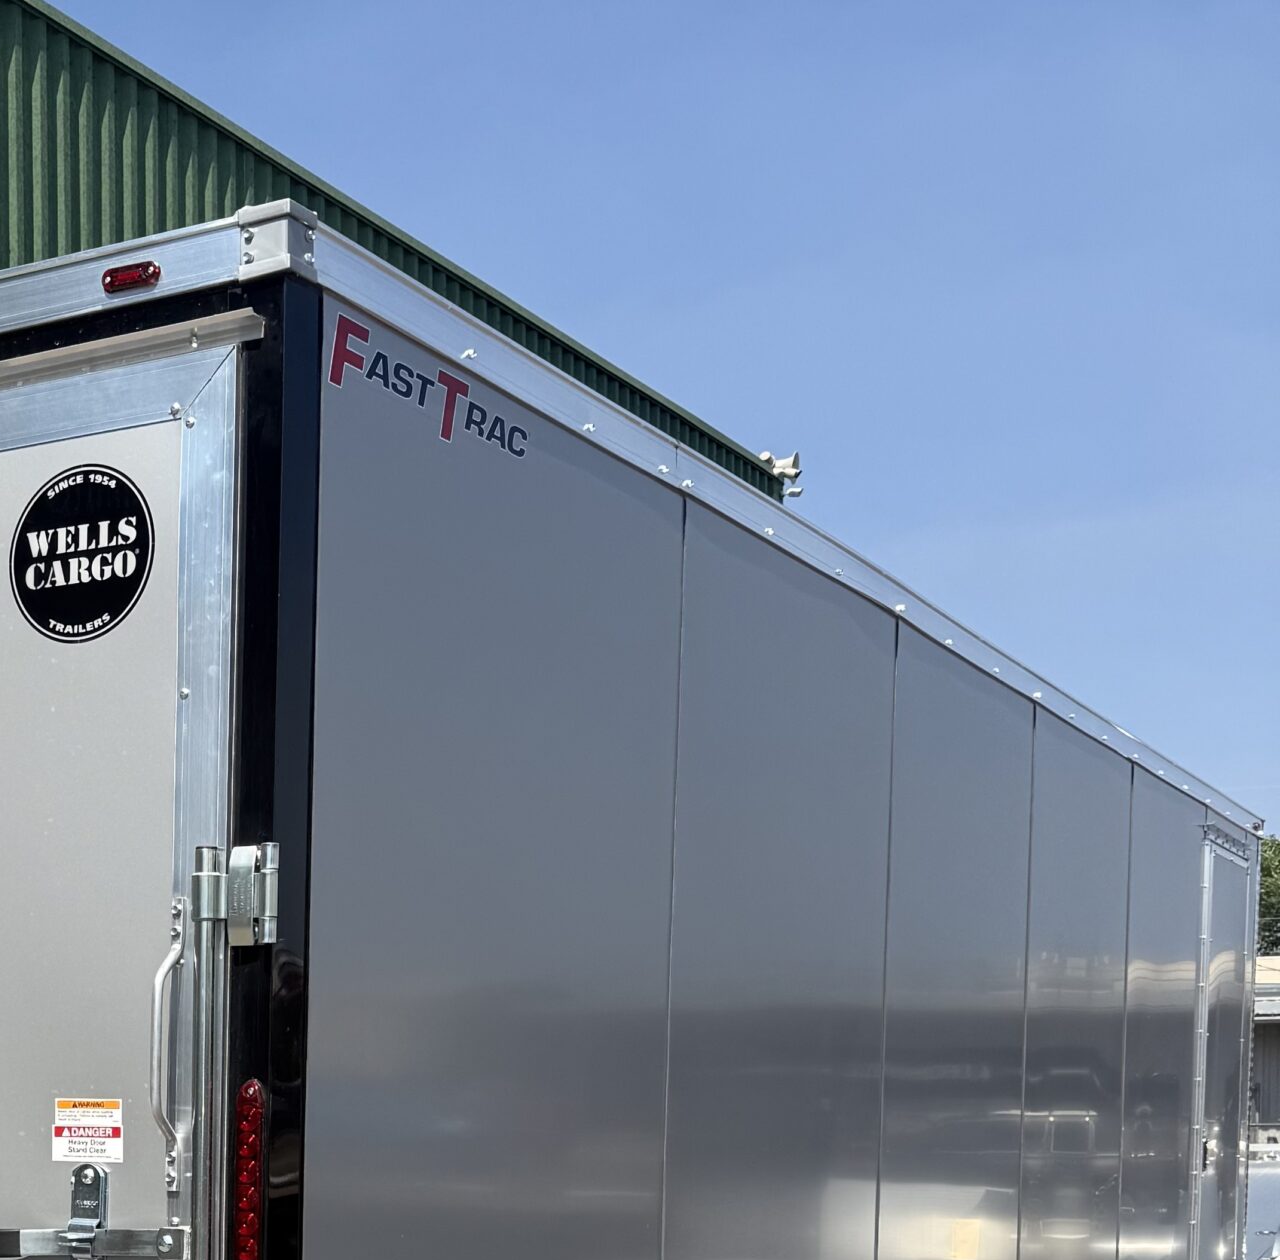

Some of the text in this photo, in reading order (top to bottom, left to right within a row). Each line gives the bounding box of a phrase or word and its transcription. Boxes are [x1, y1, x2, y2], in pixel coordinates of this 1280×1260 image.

[46, 473, 117, 499] SINCE 1954
[26, 516, 137, 558] WELLS
[25, 550, 137, 590] CARGO
[48, 612, 111, 634] TRAILERS
[71, 1127, 113, 1137] DANGER
